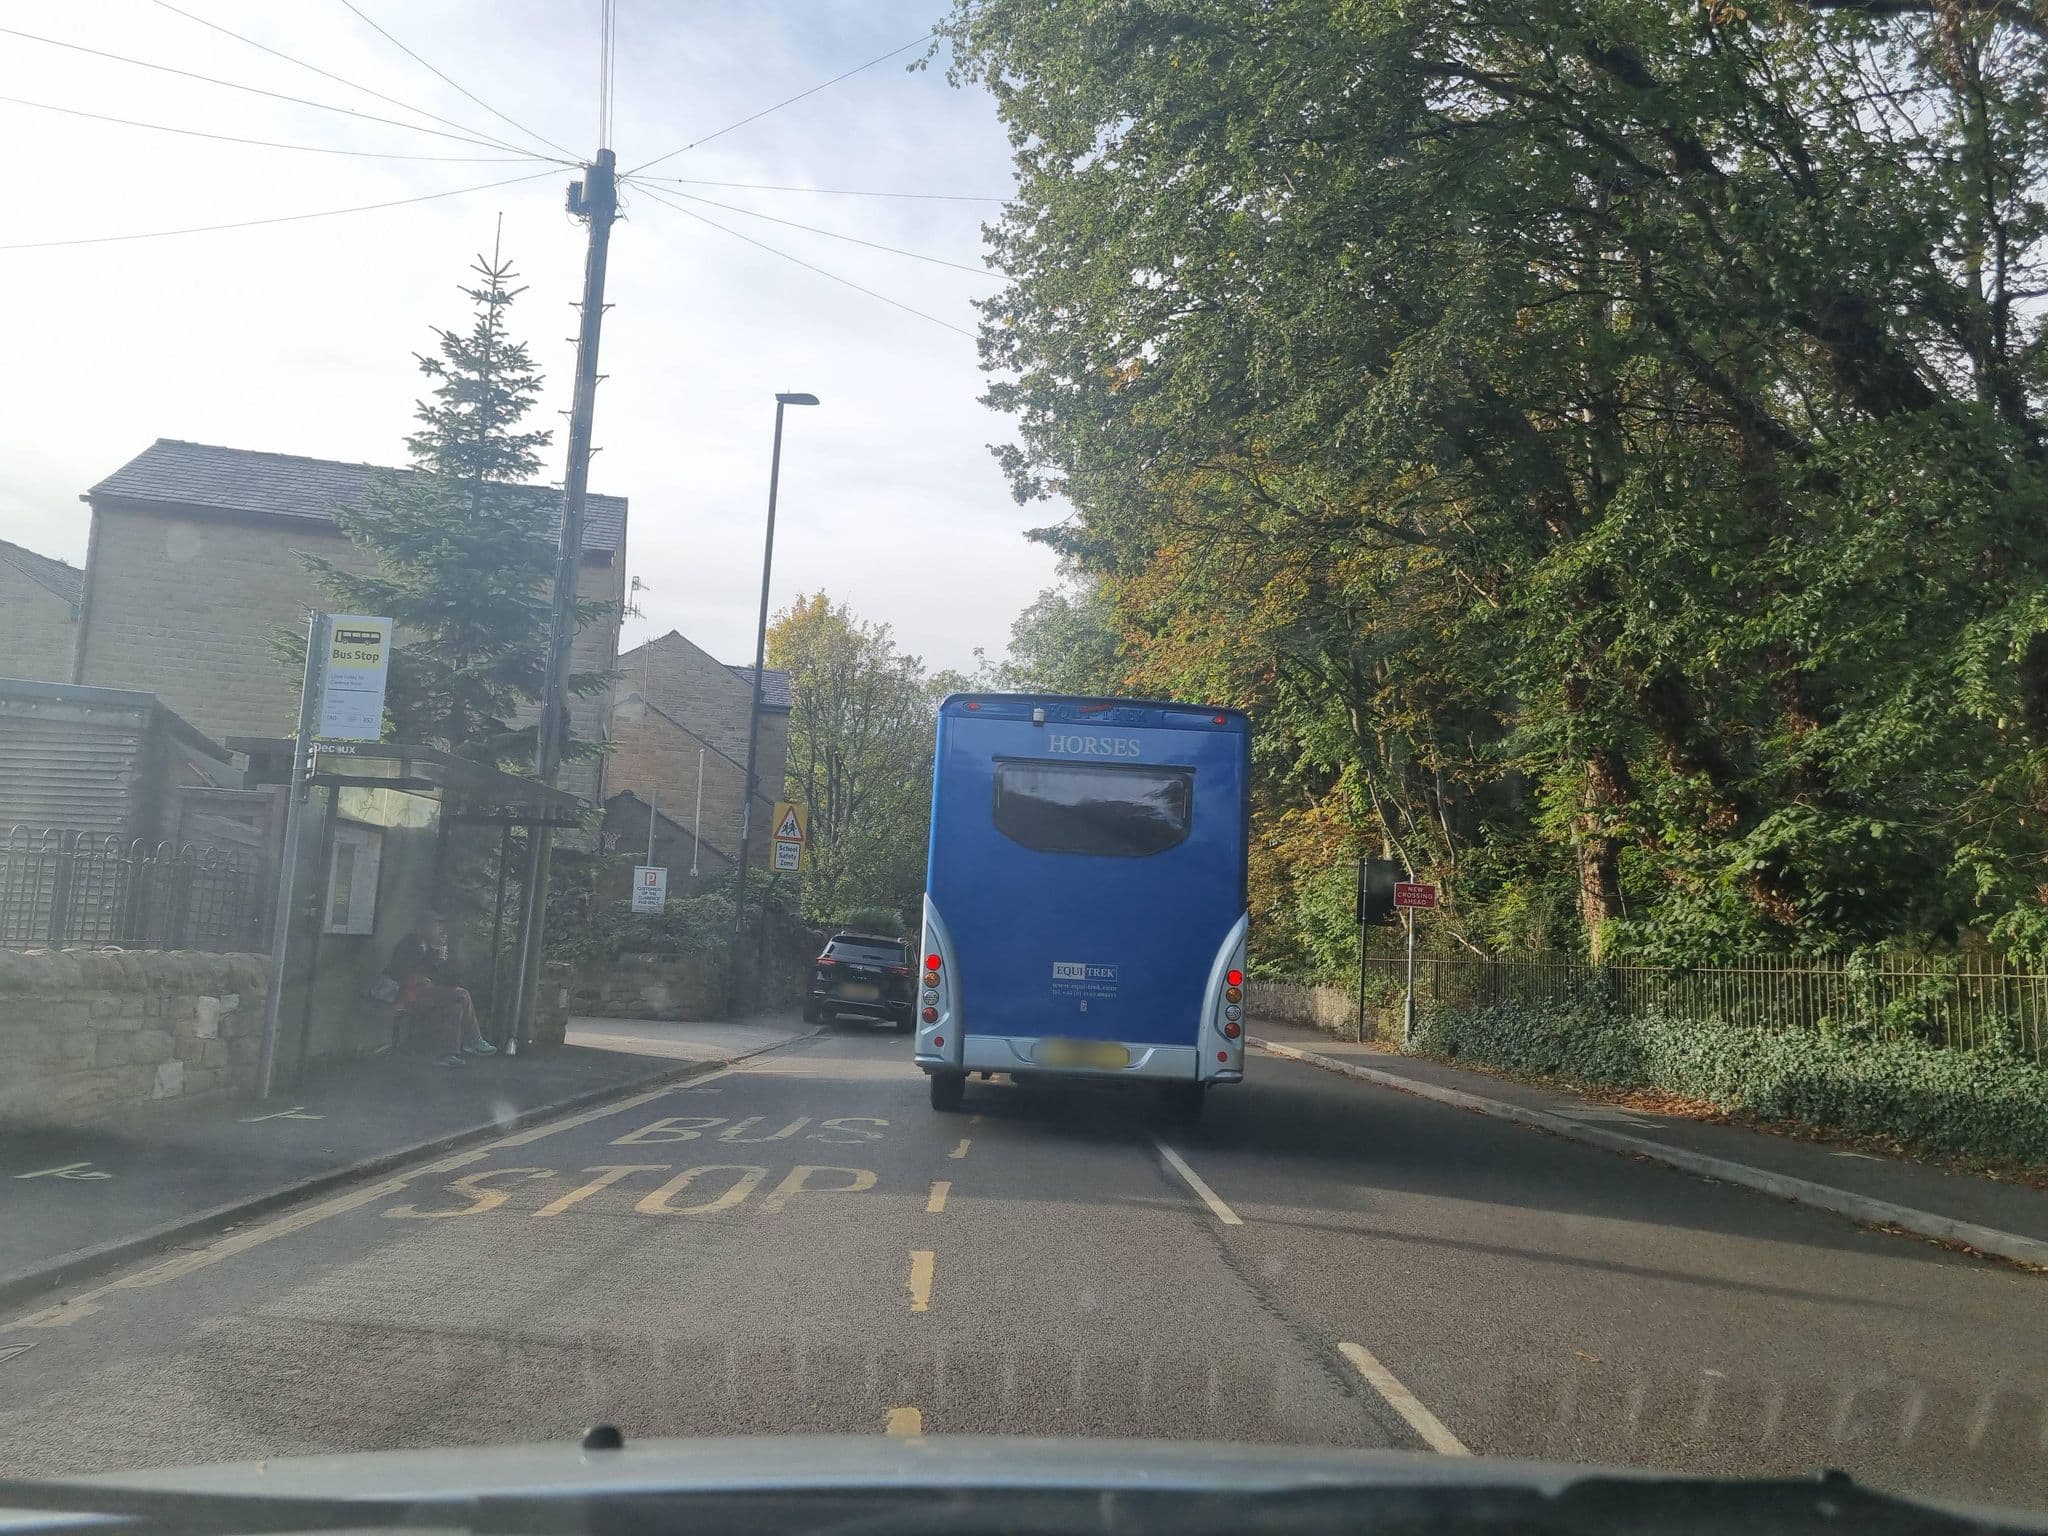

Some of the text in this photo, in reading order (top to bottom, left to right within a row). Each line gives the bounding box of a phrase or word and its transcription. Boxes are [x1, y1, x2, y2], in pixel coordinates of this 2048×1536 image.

[333, 649, 380, 663] Bus Stop
[1048, 734, 1141, 757] HORSES
[778, 844, 798, 853] School
[778, 852, 797, 861] Safety
[646, 873, 656, 886] P
[1397, 892, 1433, 900] CROSSING
[608, 1116, 890, 1145] BUS
[380, 1164, 879, 1218] STOP
